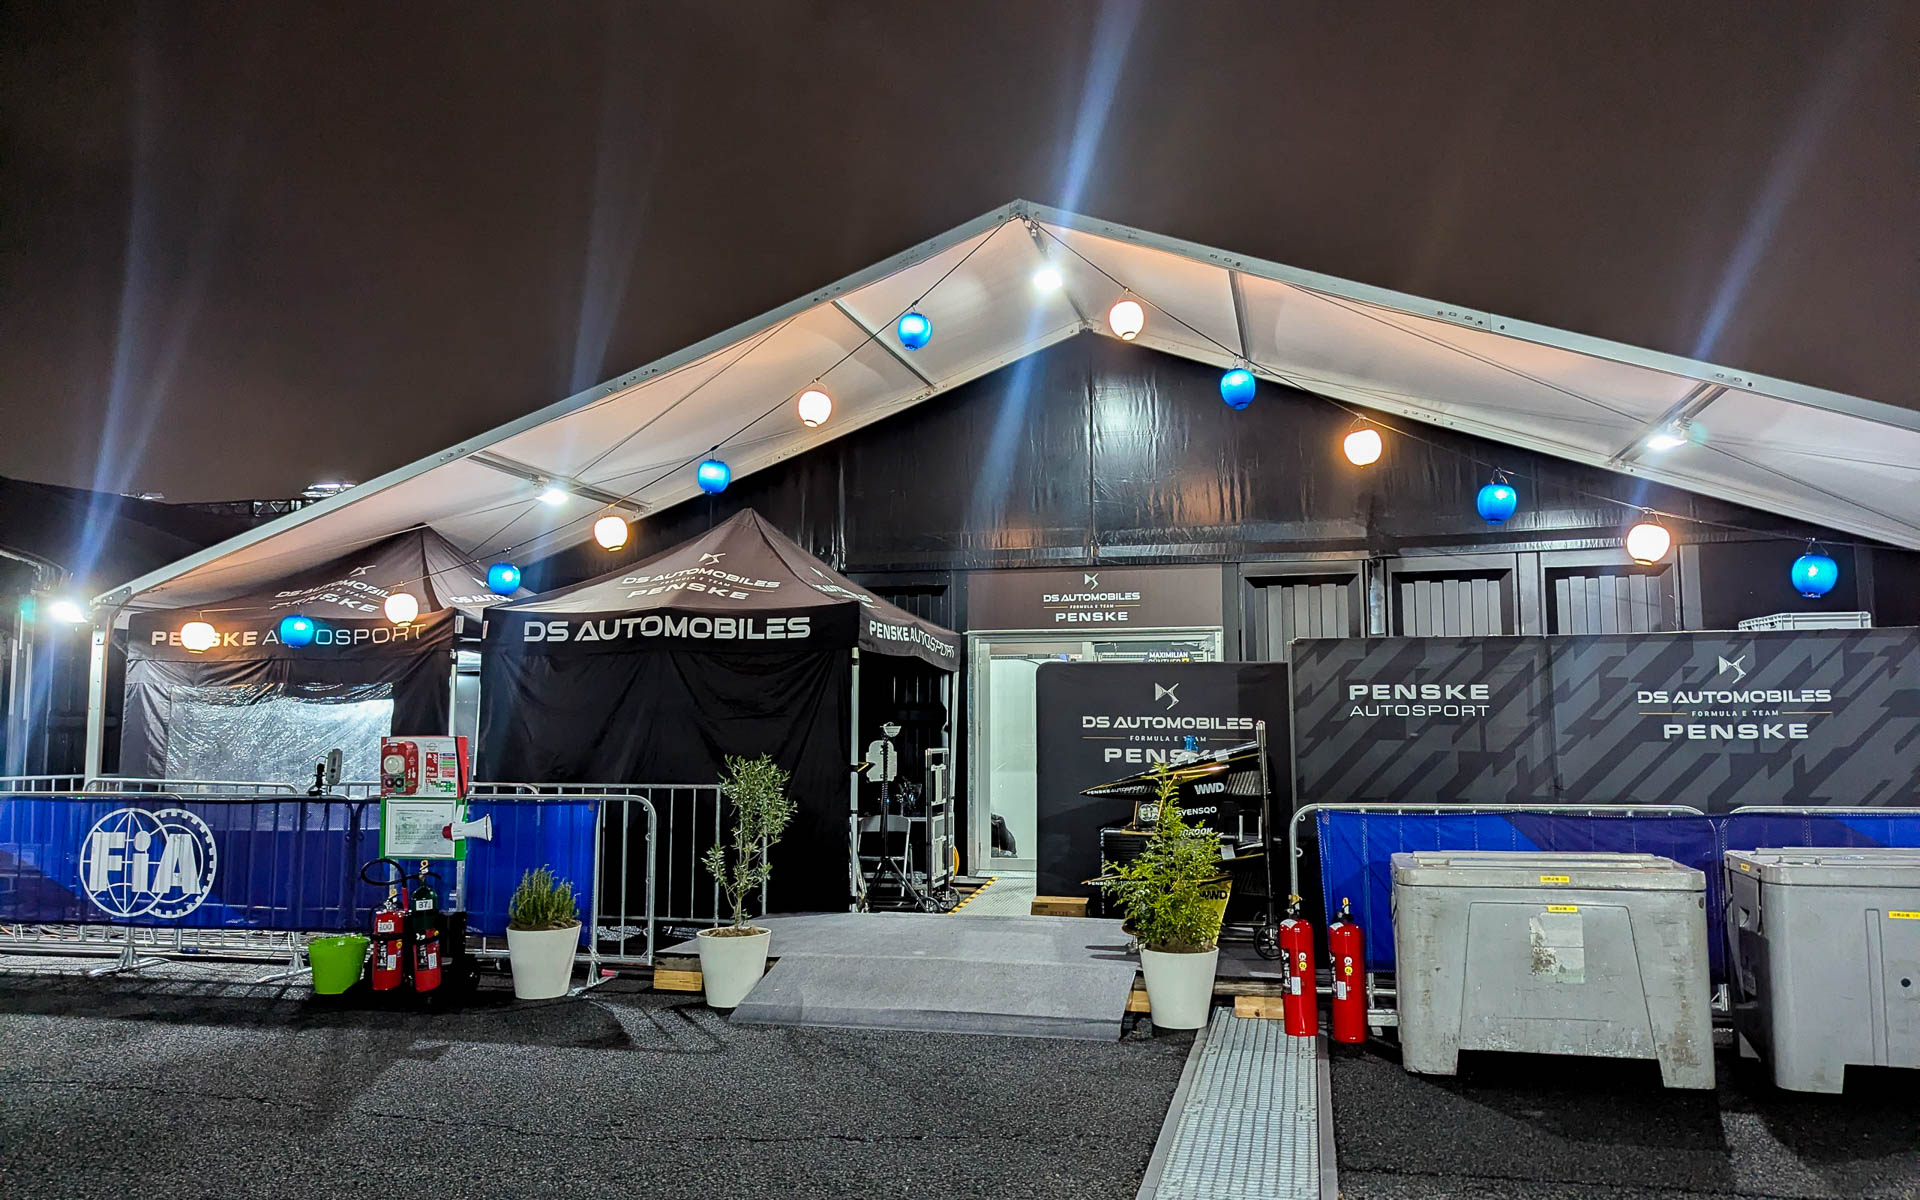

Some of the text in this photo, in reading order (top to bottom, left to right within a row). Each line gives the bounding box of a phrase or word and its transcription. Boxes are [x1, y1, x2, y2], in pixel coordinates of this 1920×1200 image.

[620, 567, 781, 588] DS AUTOMOBILES
[708, 578, 730, 587] TEAM
[300, 579, 389, 599] AUTOMOBIL
[627, 582, 750, 600] PENSKE
[1043, 592, 1141, 602] DS AUTOMOBILES
[1055, 612, 1129, 622] PENSKE
[151, 624, 427, 647] PESKE AOSPORT
[524, 616, 811, 642] DS AUTOMOBILES
[869, 620, 955, 659] PENSKE AUTOSPORT
[1349, 684, 1490, 700] PENSKE
[1637, 690, 1832, 704] DS AUTOMOBILES
[1349, 705, 1490, 717] AUTOSPORT
[1082, 716, 1254, 730] DS AUTOMOBILES
[1663, 723, 1809, 740] PENSKE
[1104, 748, 1222, 764] PENS
[1175, 806, 1217, 817] SYENSQO
